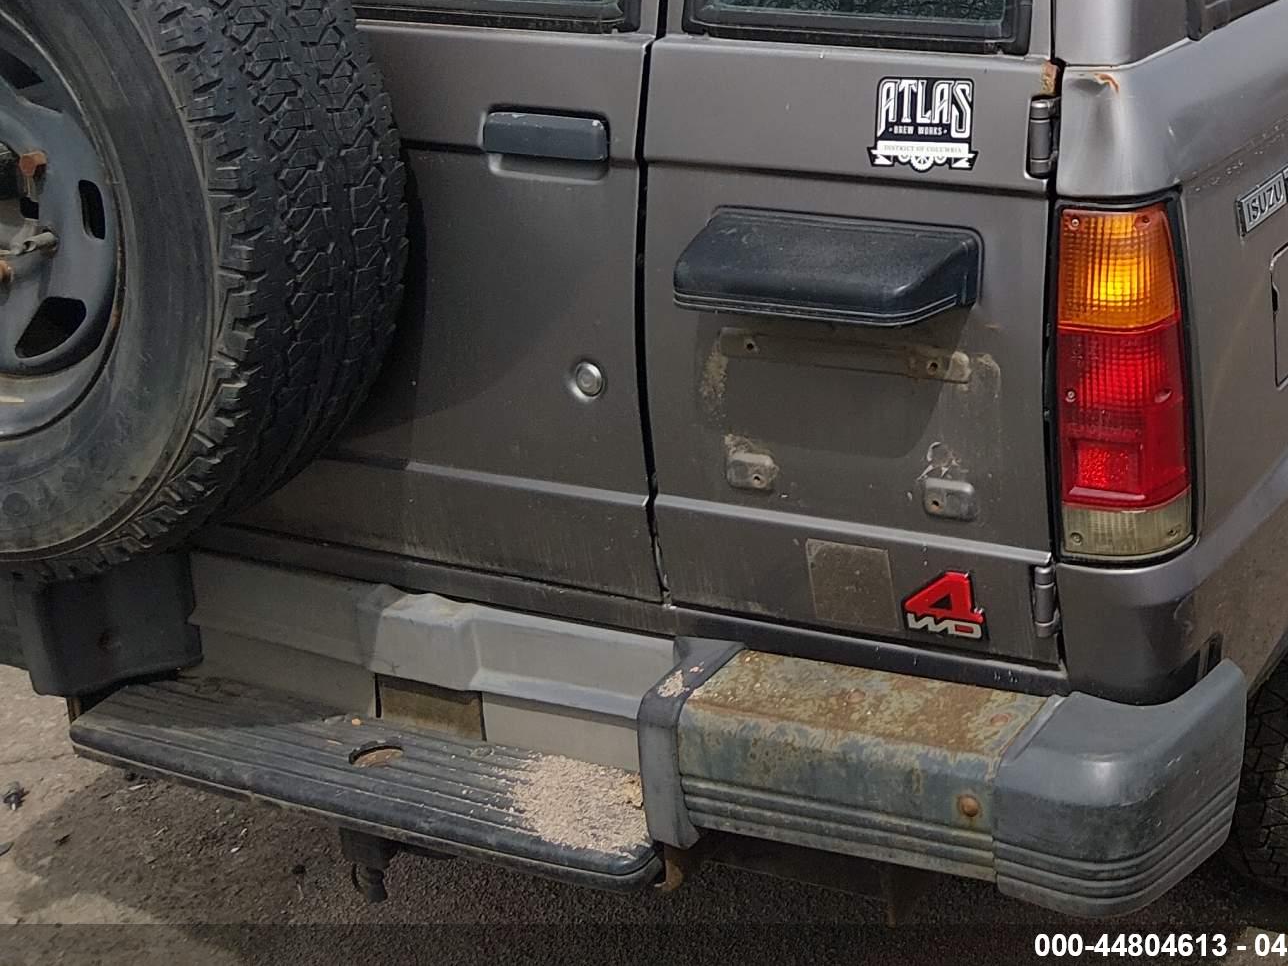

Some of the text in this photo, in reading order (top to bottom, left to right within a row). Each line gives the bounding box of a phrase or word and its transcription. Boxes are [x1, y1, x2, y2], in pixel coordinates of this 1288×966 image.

[877, 78, 973, 139] ATLAS
[893, 125, 942, 136] BREW WORKS
[1247, 177, 1284, 224] ISUZU
[905, 571, 985, 623] 4
